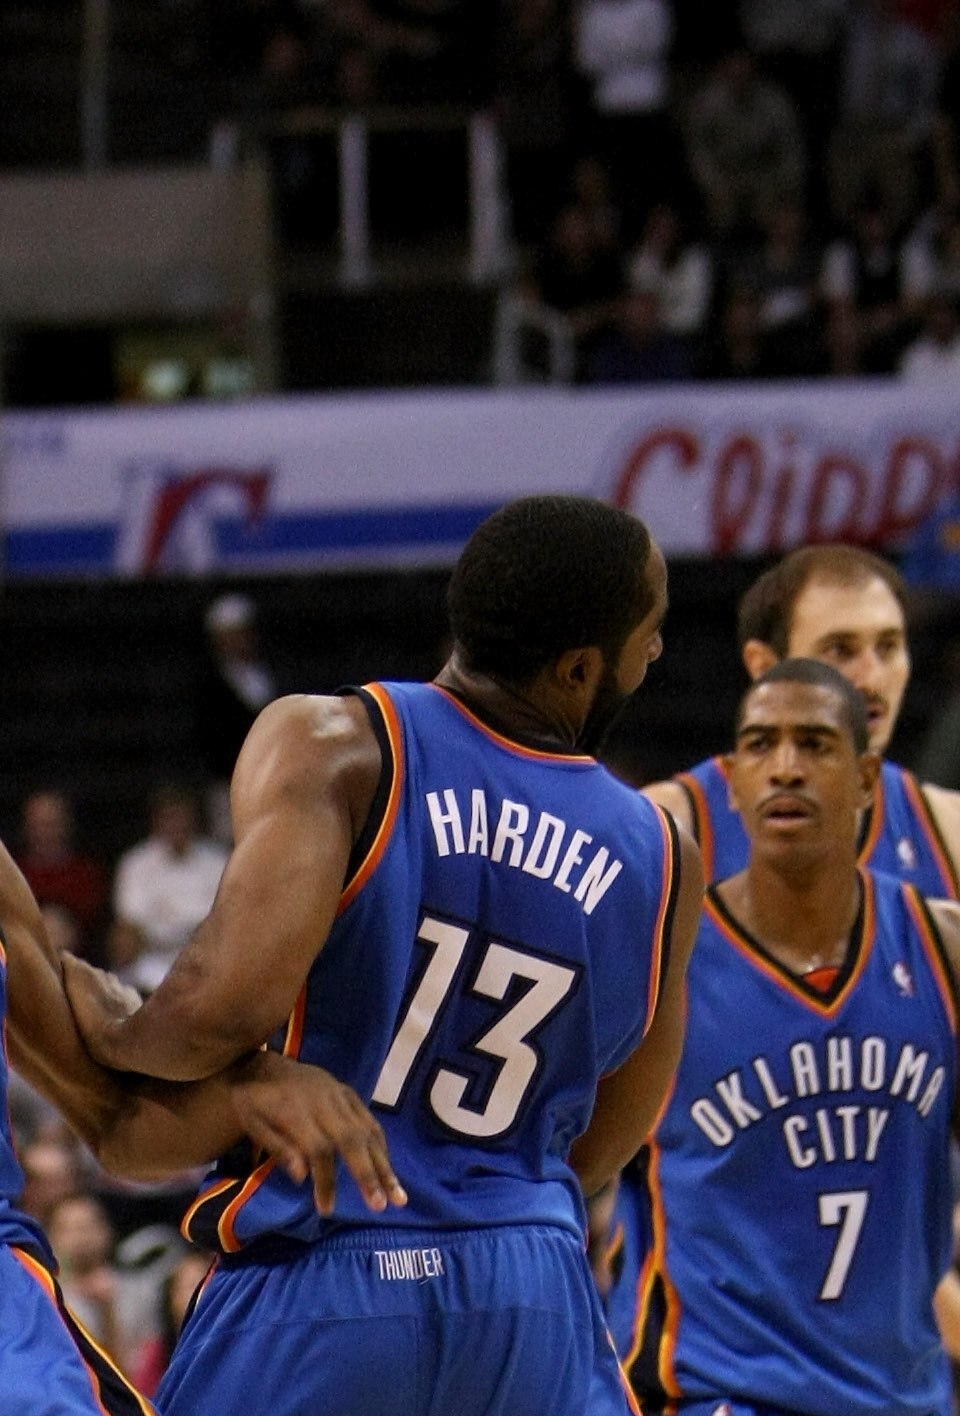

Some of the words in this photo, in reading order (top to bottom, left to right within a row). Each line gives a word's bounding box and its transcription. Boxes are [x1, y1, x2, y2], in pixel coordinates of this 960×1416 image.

[426, 788, 624, 916] HARDEN
[371, 915, 579, 1139] 13
[689, 1036, 946, 1148] OKLAHOMA
[782, 1106, 889, 1169] CITY
[374, 1247, 445, 1281] THUNDER
[818, 1190, 869, 1300] 7
